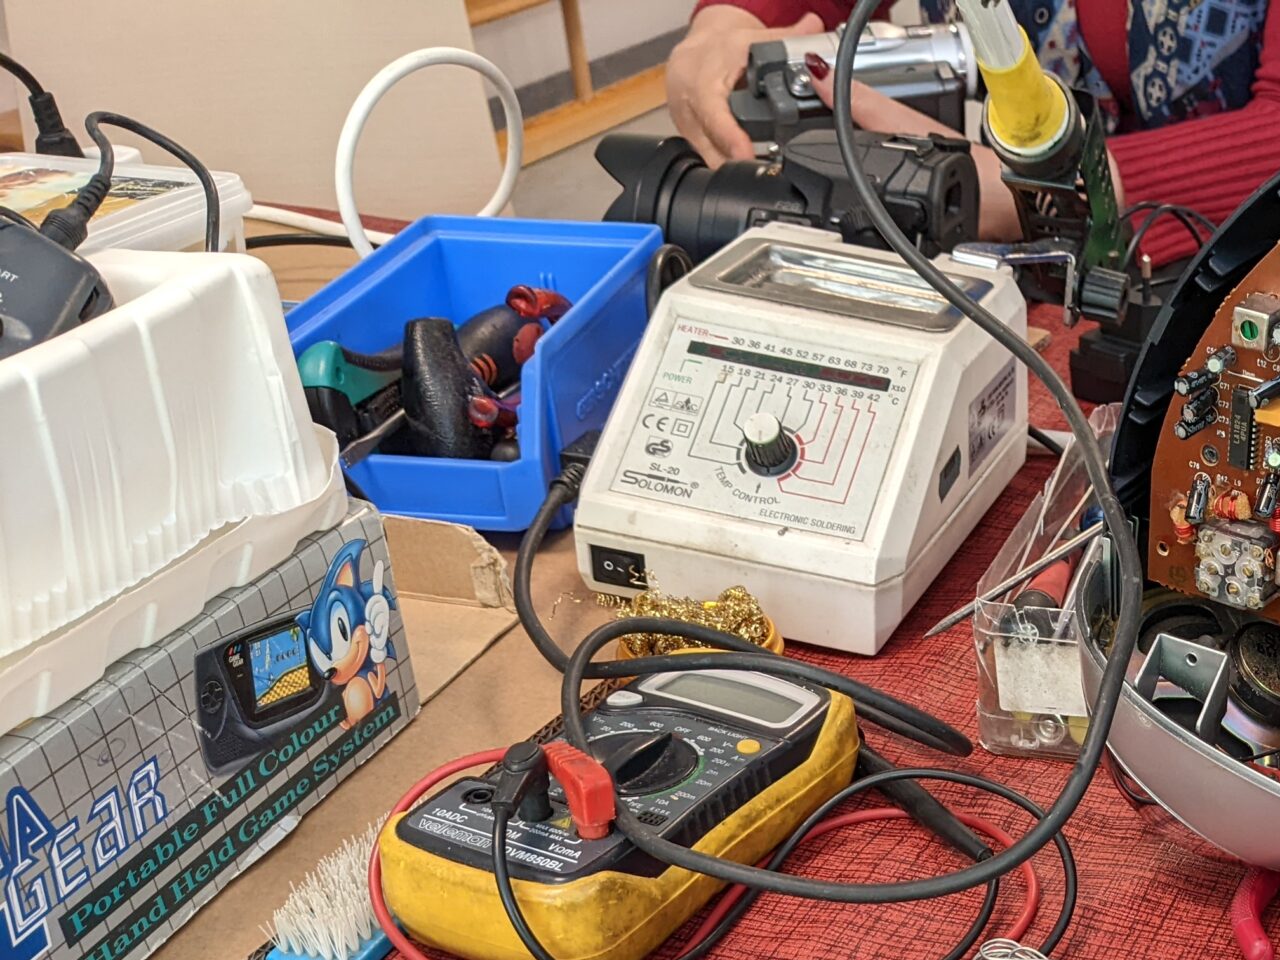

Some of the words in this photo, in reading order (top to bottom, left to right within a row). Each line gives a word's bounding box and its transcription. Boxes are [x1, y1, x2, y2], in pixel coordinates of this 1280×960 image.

[677, 324, 709, 336] HEATER
[731, 337, 745, 346] 30
[747, 340, 761, 349] 36
[764, 343, 776, 352] 41
[780, 347, 793, 356] 45
[795, 349, 809, 359] 52
[811, 352, 825, 362] 57
[828, 356, 841, 365] 63
[844, 359, 857, 369] 68
[860, 362, 873, 372] 73
[876, 365, 890, 375] 79
[662, 371, 693, 384] POWER
[721, 364, 735, 374] 15
[737, 367, 751, 377] 18
[754, 371, 766, 380] 21
[769, 374, 783, 383] 24
[786, 377, 799, 386] 27
[802, 380, 816, 390] 30
[818, 384, 832, 393] 33
[834, 387, 848, 396] 36
[850, 390, 864, 399] 39
[867, 393, 880, 402] 42
[620, 469, 693, 498] SOLOMON
[649, 463, 680, 476] SL-20
[714, 466, 733, 489] TEMP
[732, 488, 781, 504] CONTROL
[759, 509, 809, 525] ELECTRONIC
[810, 518, 856, 534] SOLDERING
[169, 836, 237, 904] Held
[238, 777, 309, 843] Game
[312, 705, 396, 783] System
[431, 807, 469, 823] 10ADC
[67, 822, 199, 936] Portable
[200, 769, 257, 826] Full
[258, 705, 340, 777] Colour
